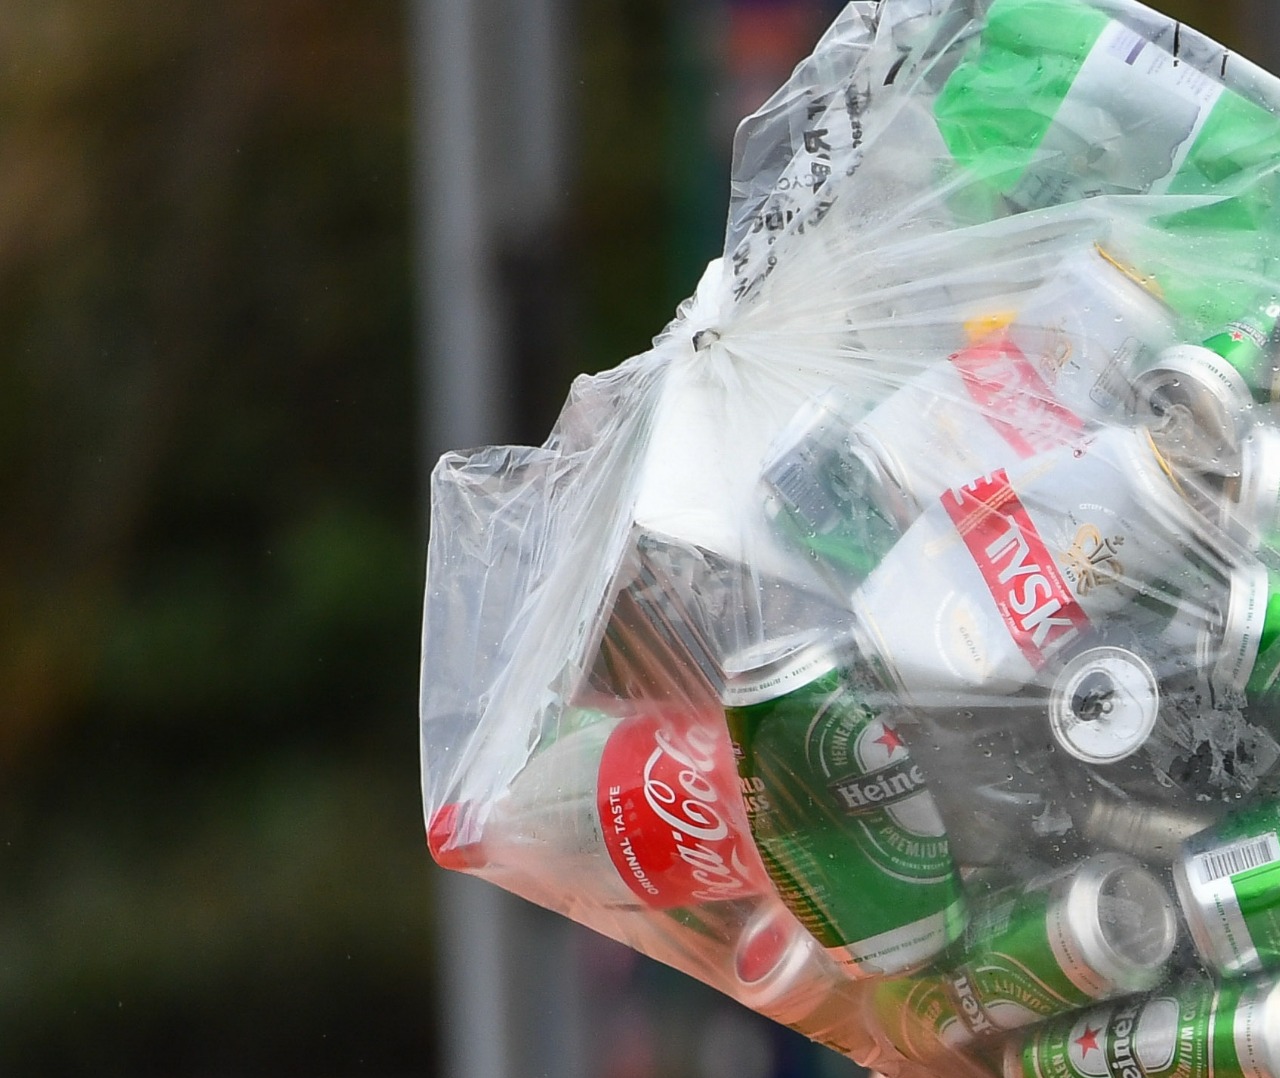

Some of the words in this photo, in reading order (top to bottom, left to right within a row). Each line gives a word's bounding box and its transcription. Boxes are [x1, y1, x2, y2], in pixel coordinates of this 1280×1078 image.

[609, 785, 626, 835] TASTE
[838, 764, 926, 809] Heine
[619, 836, 660, 896] ORIGINAL
